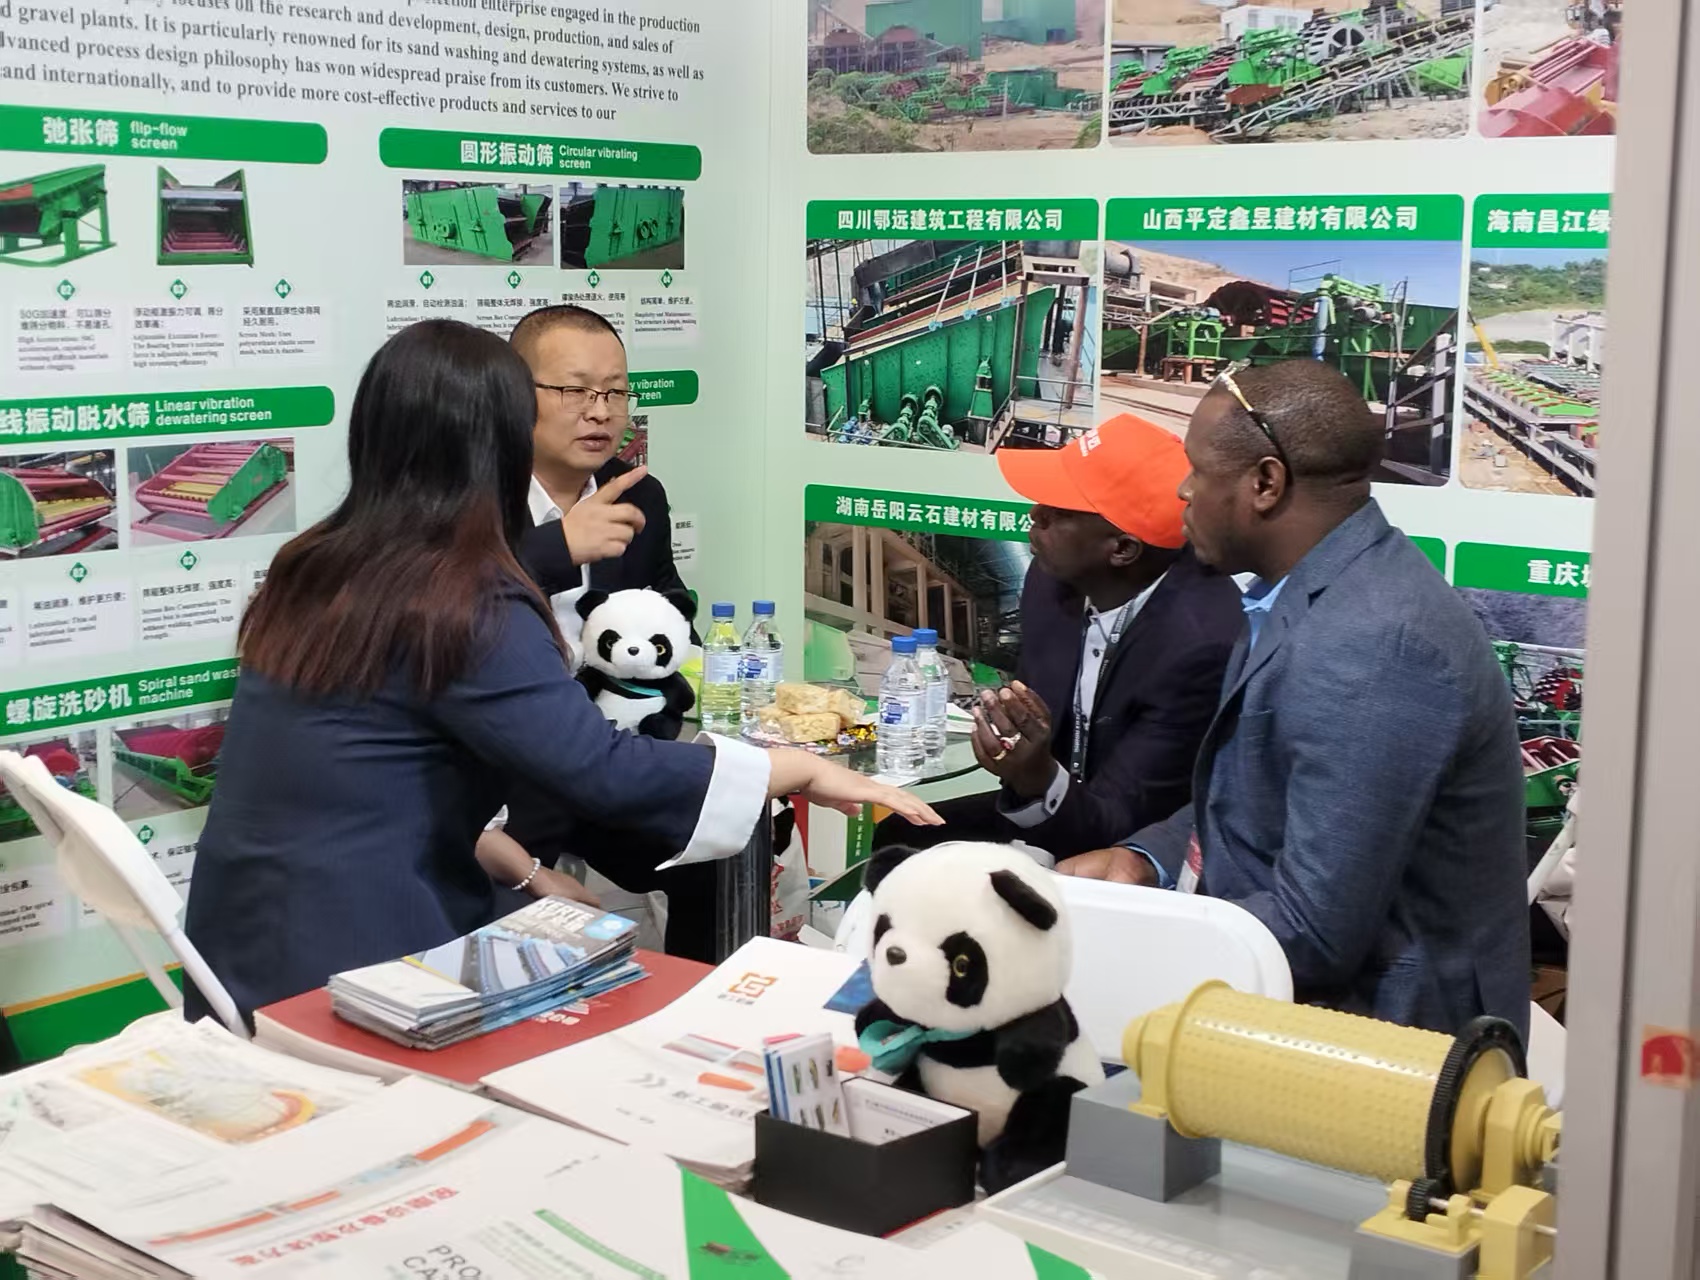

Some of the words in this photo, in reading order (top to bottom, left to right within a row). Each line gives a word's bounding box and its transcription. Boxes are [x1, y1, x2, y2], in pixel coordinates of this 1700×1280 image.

[235, 0, 253, 12] on
[260, 0, 284, 15] the
[289, 6, 352, 22] research
[357, 10, 384, 26] and
[389, 11, 481, 36] development,
[485, 21, 530, 41] design,
[534, 28, 604, 48] production,
[607, 35, 629, 50] and
[632, 37, 659, 52] sales
[662, 40, 675, 54] of
[551, 7, 599, 24] engaged
[603, 8, 614, 23] in
[618, 11, 636, 26] the
[639, 16, 700, 33] production
[18, 7, 74, 24] gravel
[81, 9, 138, 30] plants.
[145, 14, 158, 32] It
[164, 16, 176, 33] is
[182, 21, 277, 46] particularly
[282, 31, 356, 49] renowned
[361, 35, 382, 51] for
[386, 38, 403, 53] its
[407, 42, 440, 56] sand
[444, 46, 499, 65] washing
[503, 50, 527, 64] and
[531, 51, 599, 74] dewatering
[602, 60, 650, 76] systems,
[653, 65, 664, 77] as
[668, 65, 690, 79] well
[692, 68, 705, 80] as
[77, 41, 140, 59] process
[145, 44, 198, 67] design
[204, 49, 290, 74] philosophy
[296, 56, 321, 73] has
[326, 62, 355, 76] won
[360, 62, 441, 84] widespread
[445, 70, 486, 87] praise
[490, 72, 522, 90] from
[526, 75, 541, 90] its
[544, 78, 608, 96] customers.
[612, 81, 630, 97] We
[633, 85, 665, 100] strive
[668, 88, 679, 101] to
[2, 64, 36, 81] and
[43, 64, 176, 95] internationally,
[180, 76, 211, 93] and
[217, 79, 232, 94] to
[237, 81, 296, 100] provide
[301, 87, 340, 102] more
[344, 89, 435, 108] cost-effective
[440, 95, 499, 113] products
[502, 100, 526, 114] and
[530, 102, 578, 118] services
[581, 105, 593, 119] to
[596, 108, 617, 121] our
[42, 116, 120, 147] 弛张筛
[129, 121, 188, 137] flip-flow
[130, 137, 178, 151] screen
[460, 140, 554, 167] 圆形振动筛
[559, 145, 596, 158] Circular
[598, 147, 638, 163] vibrating
[559, 159, 591, 170] screen
[838, 208, 1063, 231] 四川鄂远建筑工程有限公司
[1143, 206, 1419, 231] 山西平定鑫昱建材有限公司
[637, 379, 675, 390] vibration
[155, 399, 197, 413] Linear
[199, 396, 255, 411] vibration
[155, 411, 228, 427] dewatering
[229, 408, 272, 422] screen
[138, 675, 178, 692] Spiral
[179, 671, 210, 685] sand
[6, 684, 132, 725] 螺旋洗砂机
[139, 688, 194, 706] machine
